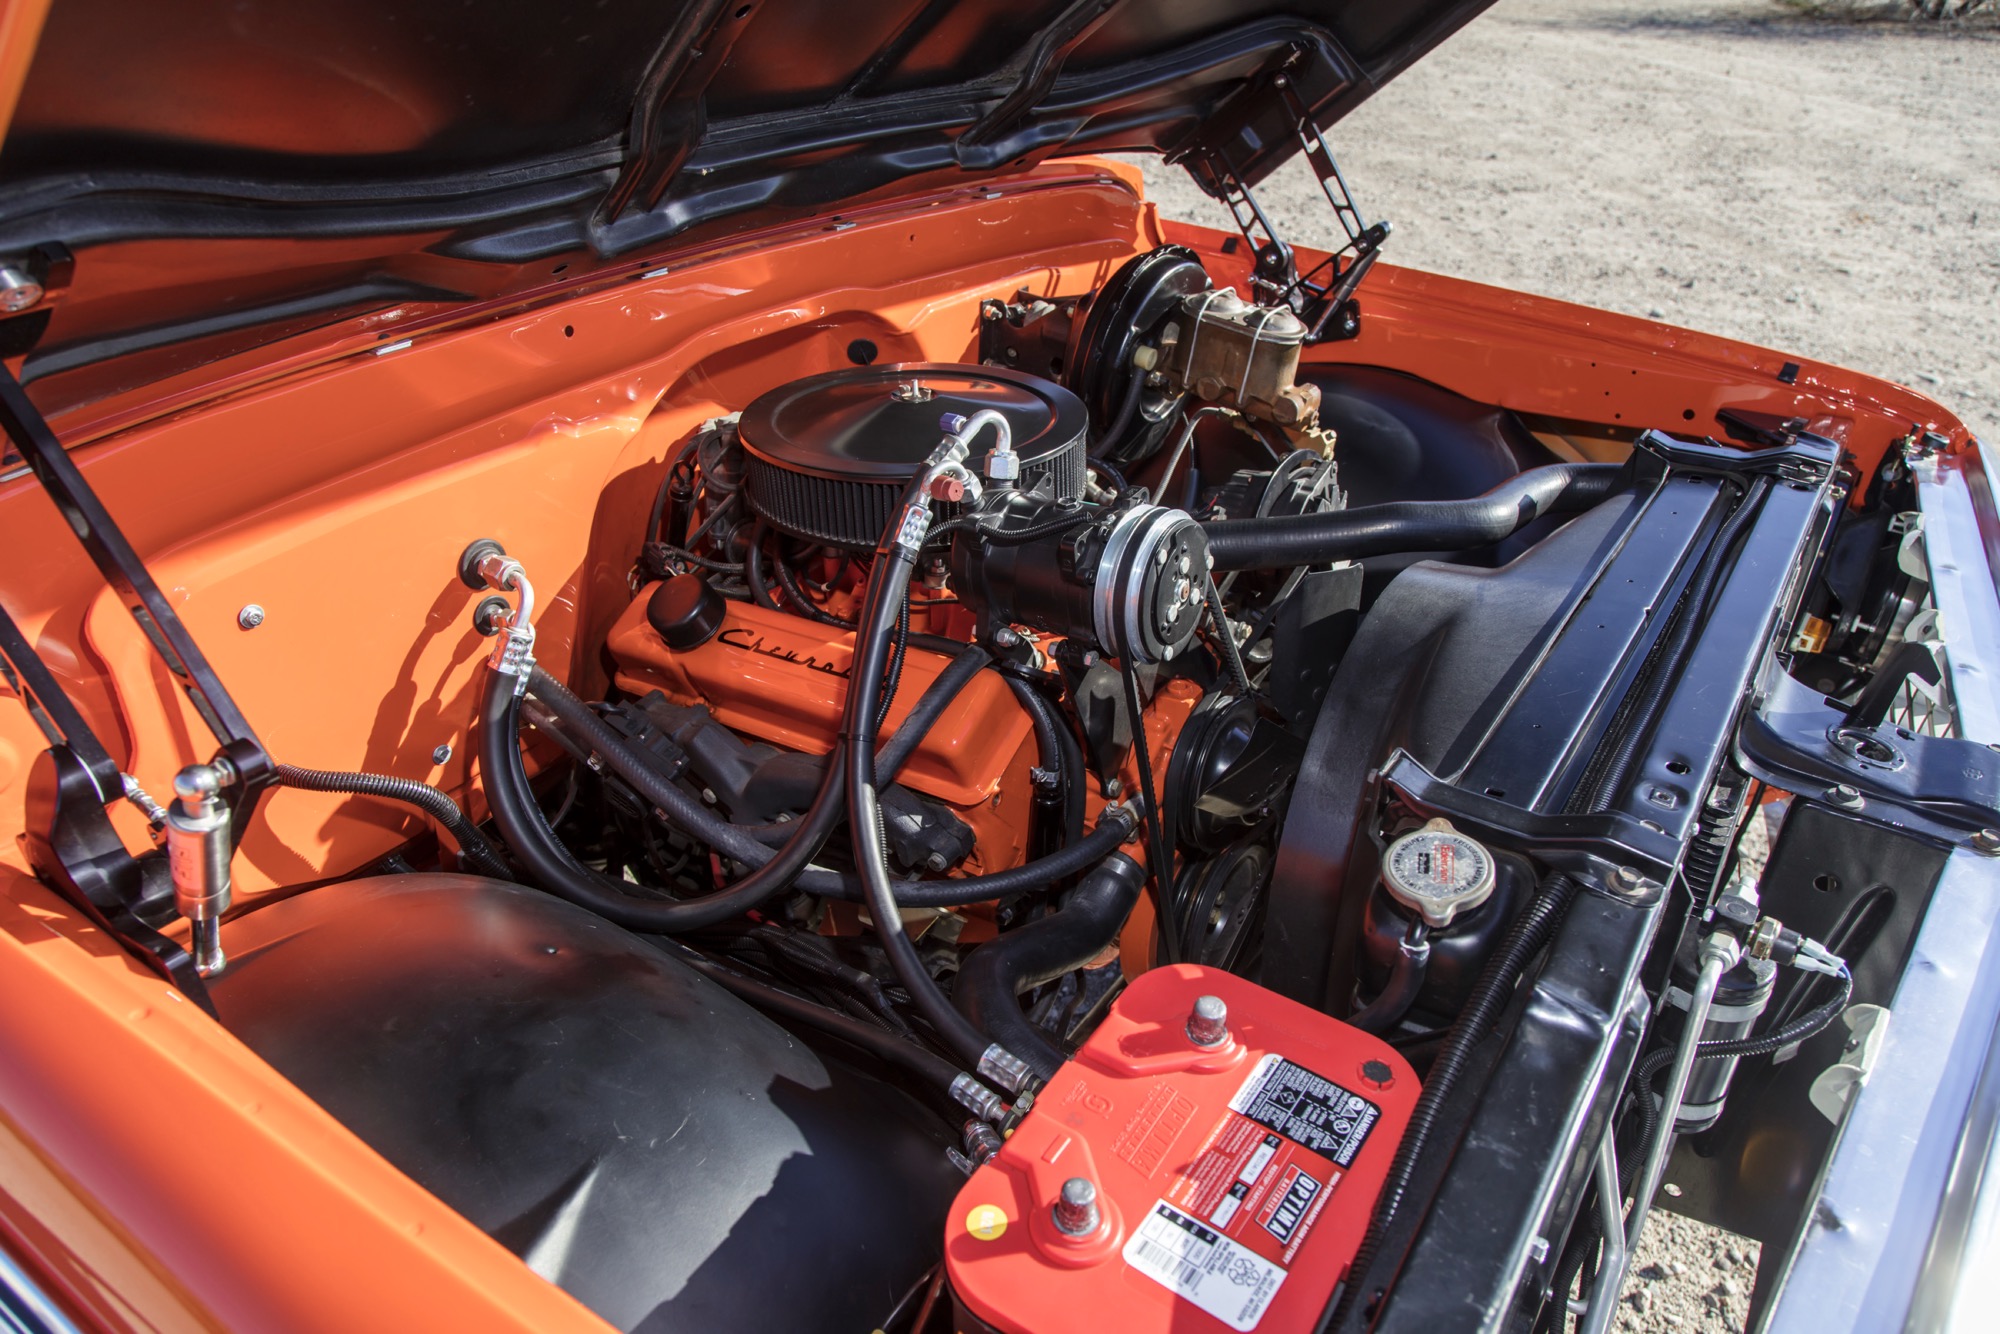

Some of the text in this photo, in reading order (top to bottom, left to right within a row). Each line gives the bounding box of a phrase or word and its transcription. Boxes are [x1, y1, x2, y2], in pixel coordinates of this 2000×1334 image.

[1131, 1094, 1195, 1173] OPTIMA
[1336, 1113, 1374, 1165] DANGER/POISON
[1263, 1177, 1290, 1214] BATTERIES
[1267, 1173, 1318, 1238] OPTIMA
[1280, 1236, 1302, 1264] BATTERY
